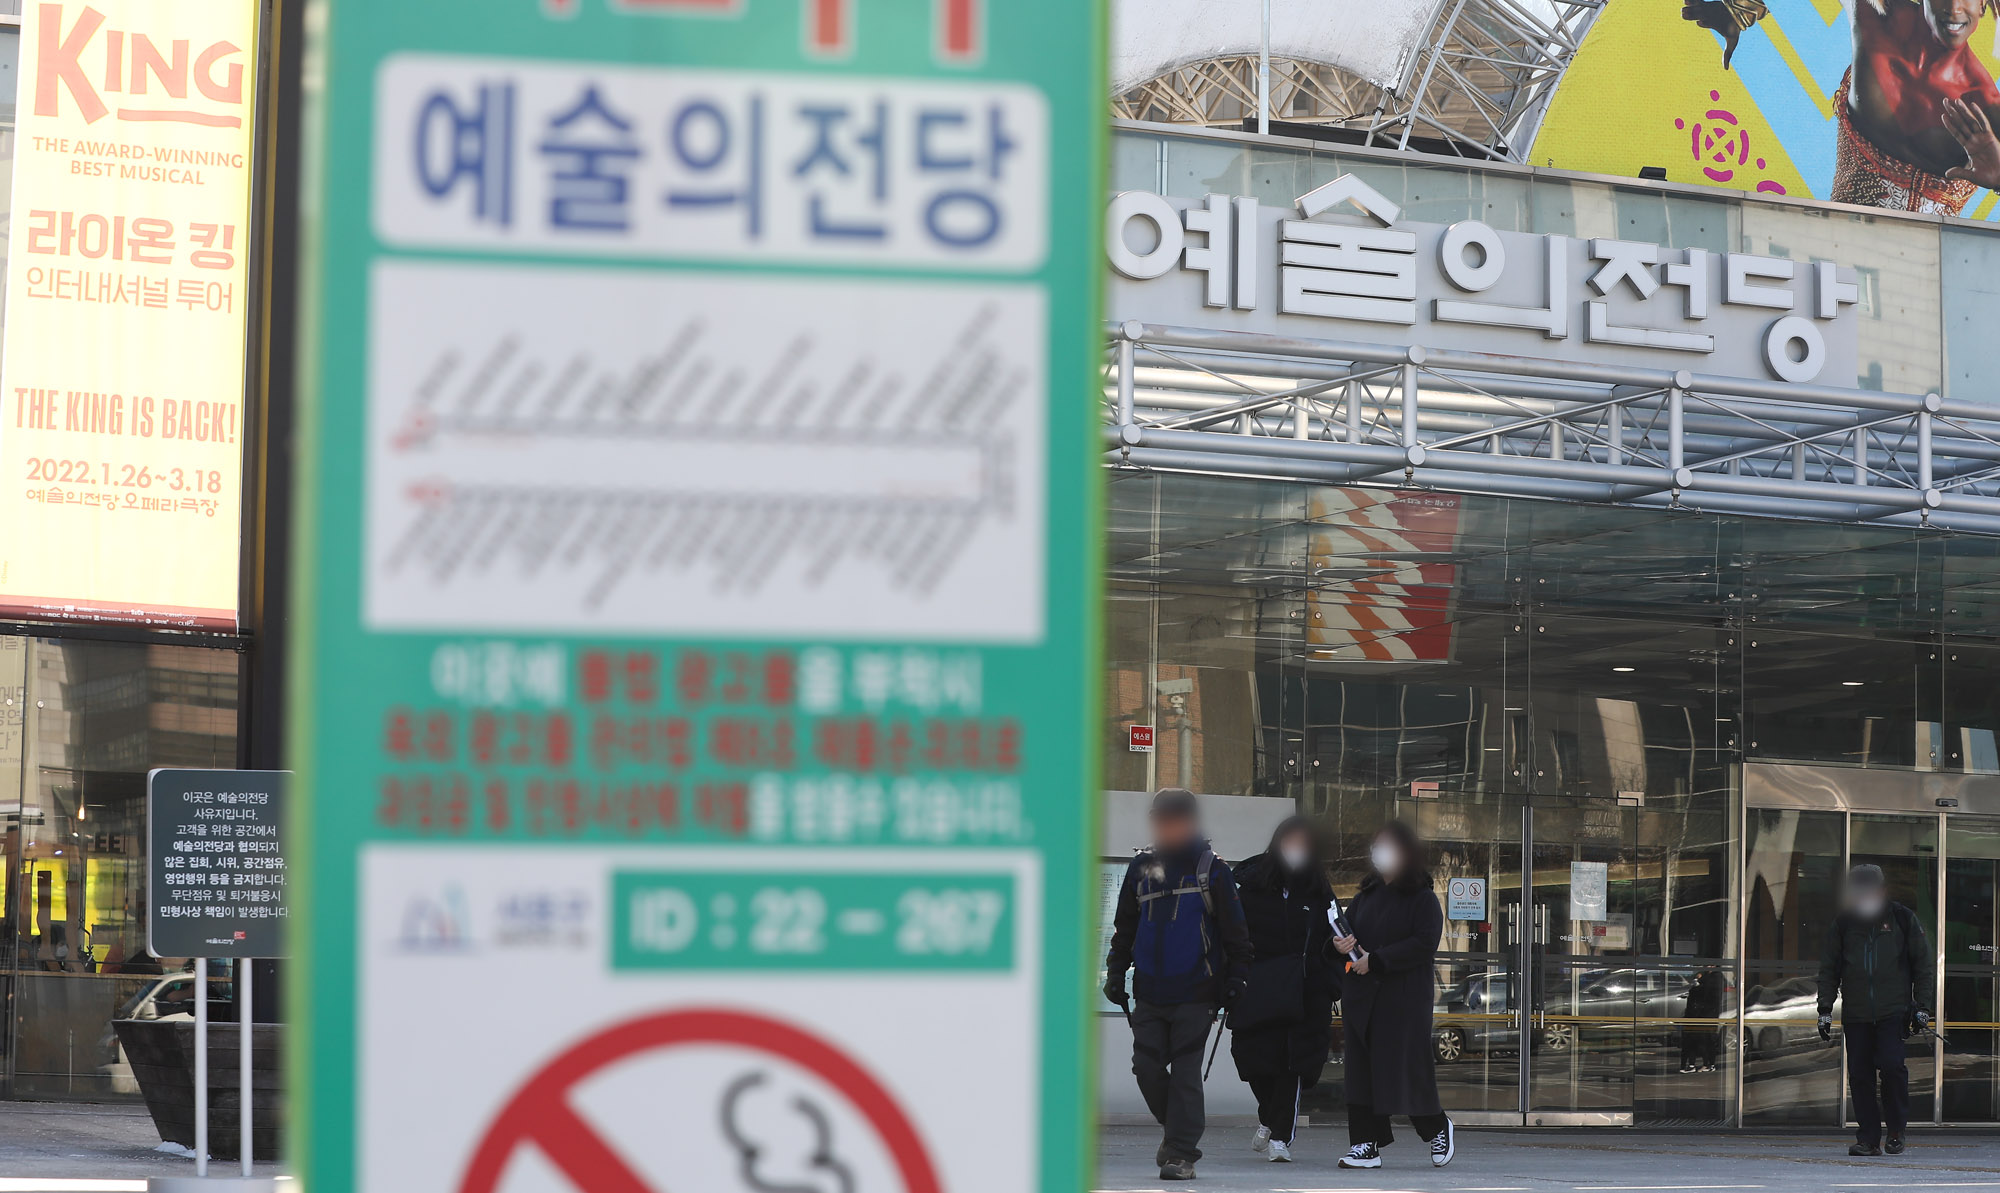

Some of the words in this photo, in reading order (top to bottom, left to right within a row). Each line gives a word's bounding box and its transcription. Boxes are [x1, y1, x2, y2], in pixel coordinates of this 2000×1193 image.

[34, 3, 244, 125] KING
[33, 136, 69, 153] THE
[73, 140, 244, 169] AWARD-WINNING
[411, 77, 1020, 253] 예술의전당
[71, 160, 115, 177] BEST
[120, 164, 205, 185] MUSICAL
[27, 209, 176, 265] 라이온
[189, 222, 236, 270] 킹
[27, 266, 168, 309] 인터내셔널
[176, 278, 233, 314] 투어
[1106, 172, 1858, 384] 예술의전당
[14, 387, 59, 430] THE
[65, 391, 124, 436] KING
[131, 396, 154, 438] IS
[162, 399, 236, 444] BACK!
[26, 457, 222, 494] 2022.1.26~3.18
[26, 486, 119, 511] 예술의전당
[121, 492, 219, 517] 오페라극장
[183, 792, 214, 804] 이곳은
[218, 792, 268, 805] 예술의전당
[194, 808, 258, 820] 사유지입니다.
[176, 824, 207, 836] 고객을
[211, 825, 232, 836] 위한
[235, 825, 276, 837] 공간에서
[173, 841, 235, 853] 예술의전당과
[238, 841, 279, 853] 협의되지
[164, 857, 185, 869] 않은
[189, 857, 212, 869] 집회,
[216, 857, 240, 869] 시위,
[243, 858, 288, 869] 공간점유,
[165, 873, 206, 885] 영업행위
[209, 873, 230, 885] 등을
[233, 874, 287, 886] 금지합니다.
[171, 890, 212, 901] 무단점유
[216, 890, 226, 902] 및
[230, 890, 281, 902] 퇴거불응시
[160, 906, 201, 918] 민형사상
[204, 906, 235, 918] 책임이
[633, 891, 696, 952] ID
[750, 890, 828, 953] 22
